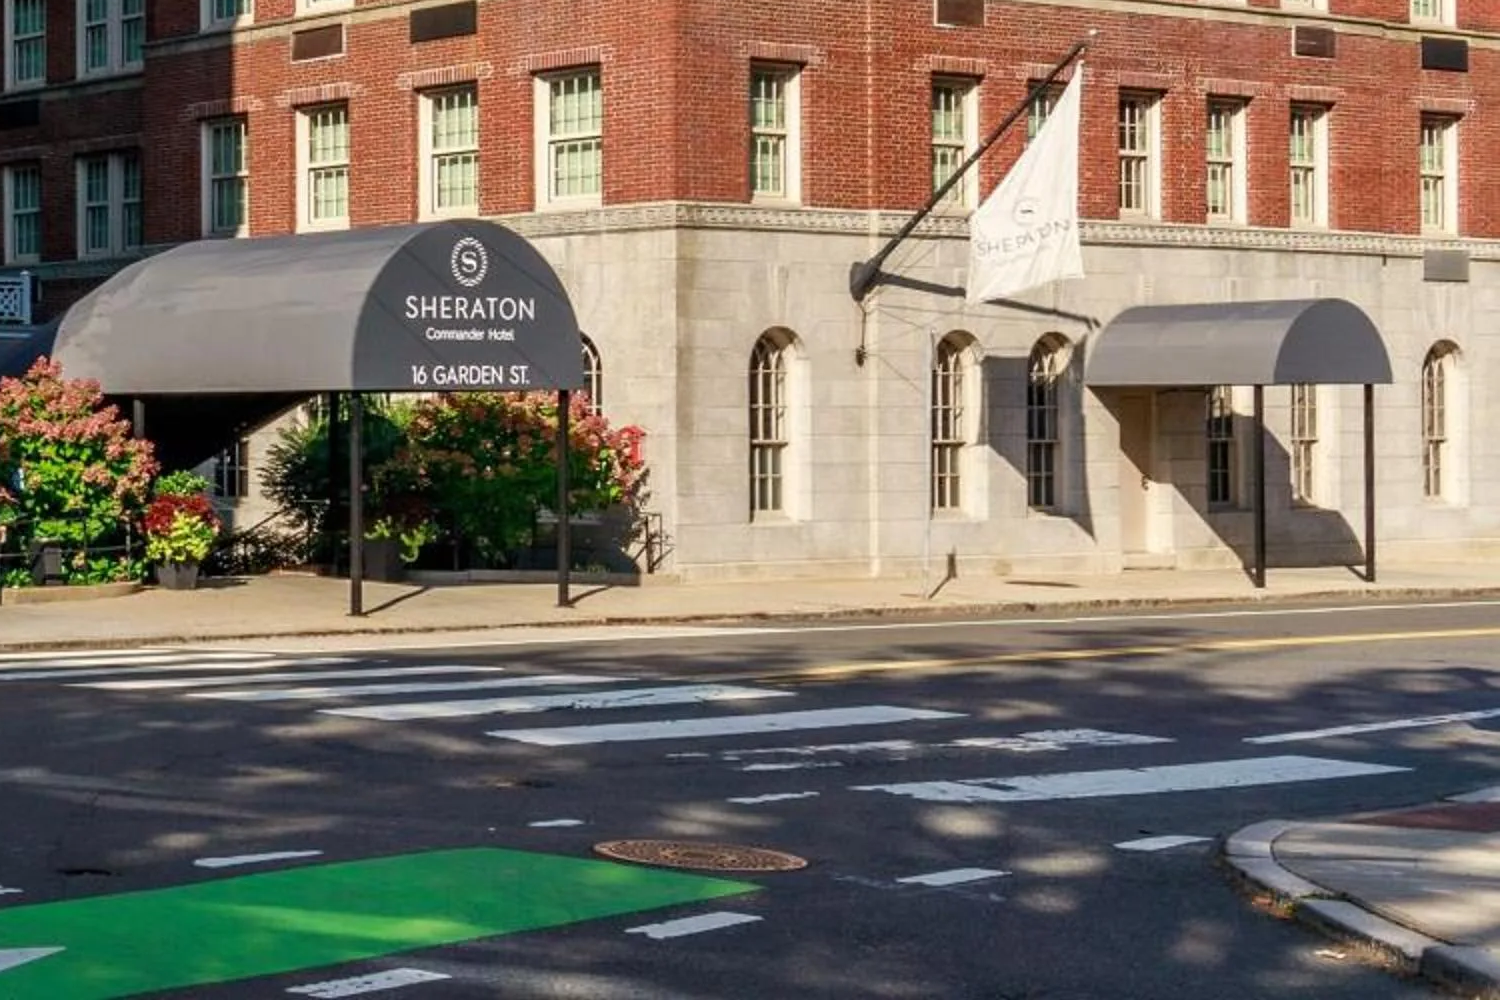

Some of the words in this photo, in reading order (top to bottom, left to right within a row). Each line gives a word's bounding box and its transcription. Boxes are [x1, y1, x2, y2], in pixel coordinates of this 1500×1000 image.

[461, 251, 477, 273] S
[405, 295, 535, 321] SHERATON
[425, 327, 485, 341] Commander
[487, 327, 515, 342] Hotel
[411, 365, 427, 385] 16
[433, 364, 503, 386] GARDEN
[509, 365, 531, 385] ST.
